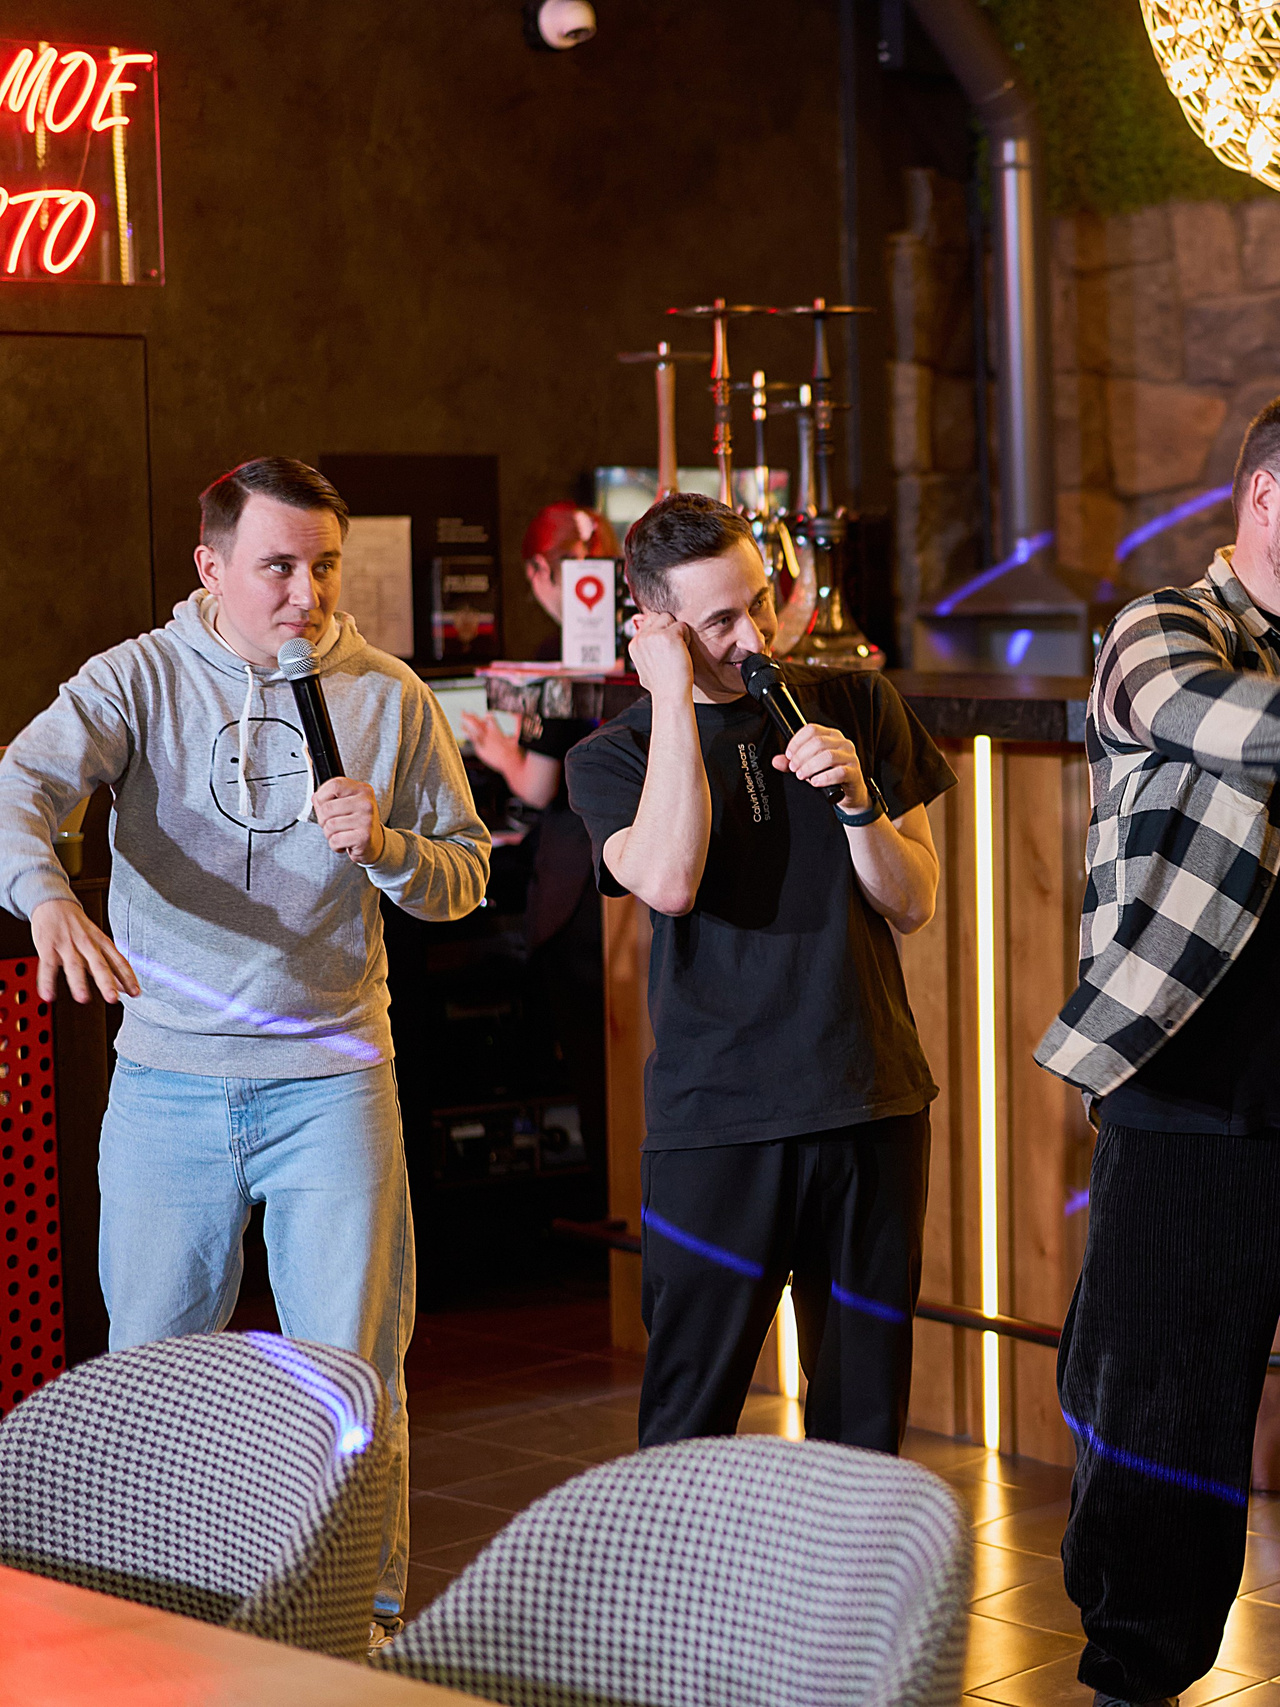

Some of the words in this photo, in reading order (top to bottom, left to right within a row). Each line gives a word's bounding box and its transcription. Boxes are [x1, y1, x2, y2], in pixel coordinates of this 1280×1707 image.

[738, 743, 749, 771] Jeans
[744, 772, 756, 793] Klein
[747, 742, 759, 771] Calvin
[754, 770, 766, 792] Klein
[760, 793, 771, 821] Jeans
[750, 793, 761, 823] Calvin
